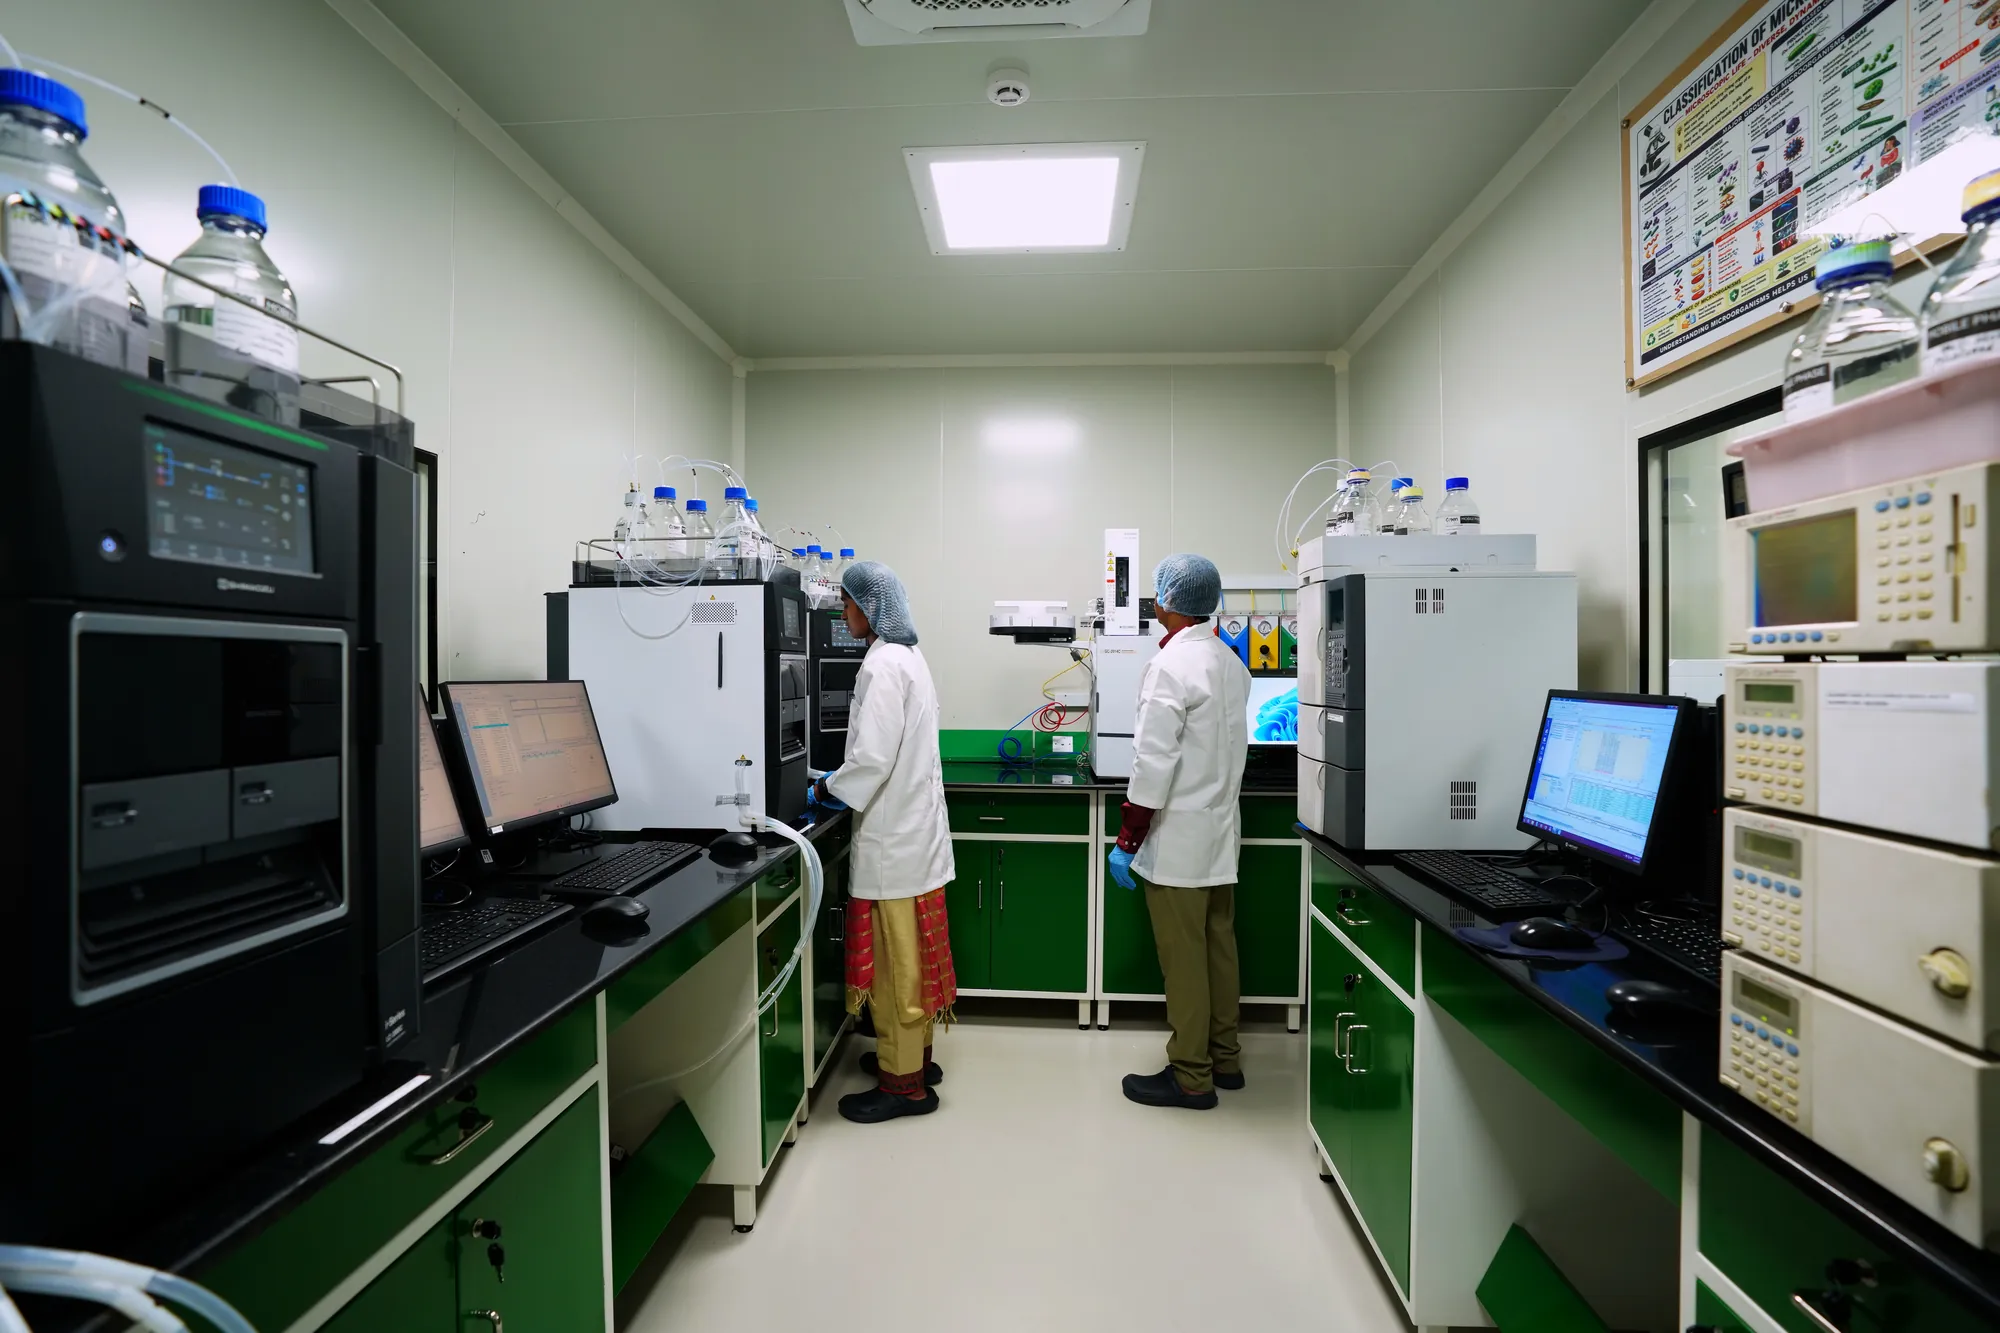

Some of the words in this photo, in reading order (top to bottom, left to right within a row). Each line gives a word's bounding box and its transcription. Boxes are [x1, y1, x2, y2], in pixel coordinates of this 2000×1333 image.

[1663, 37, 1747, 126] CLASSIFICATION
[1751, 20, 1766, 49] OF
[1685, 71, 1729, 116] MICROSCOPIC
[1731, 58, 1745, 76] LIFE
[1753, 22, 1787, 58] DIVERSE,
[1722, 114, 1742, 134] MAJOR
[1744, 93, 1768, 118] GROUPS
[1770, 85, 1779, 97] OF
[1781, 33, 1844, 89] MICROORGANISMS
[1659, 323, 1708, 353] UNDERSTANDING
[1711, 292, 1770, 328] MICROORGANISMS
[1772, 279, 1795, 297] HELPS
[1798, 273, 1808, 284] US
[1668, 304, 1693, 321] IMPORTANCE
[1700, 278, 1741, 304] MICROORGANISMS
